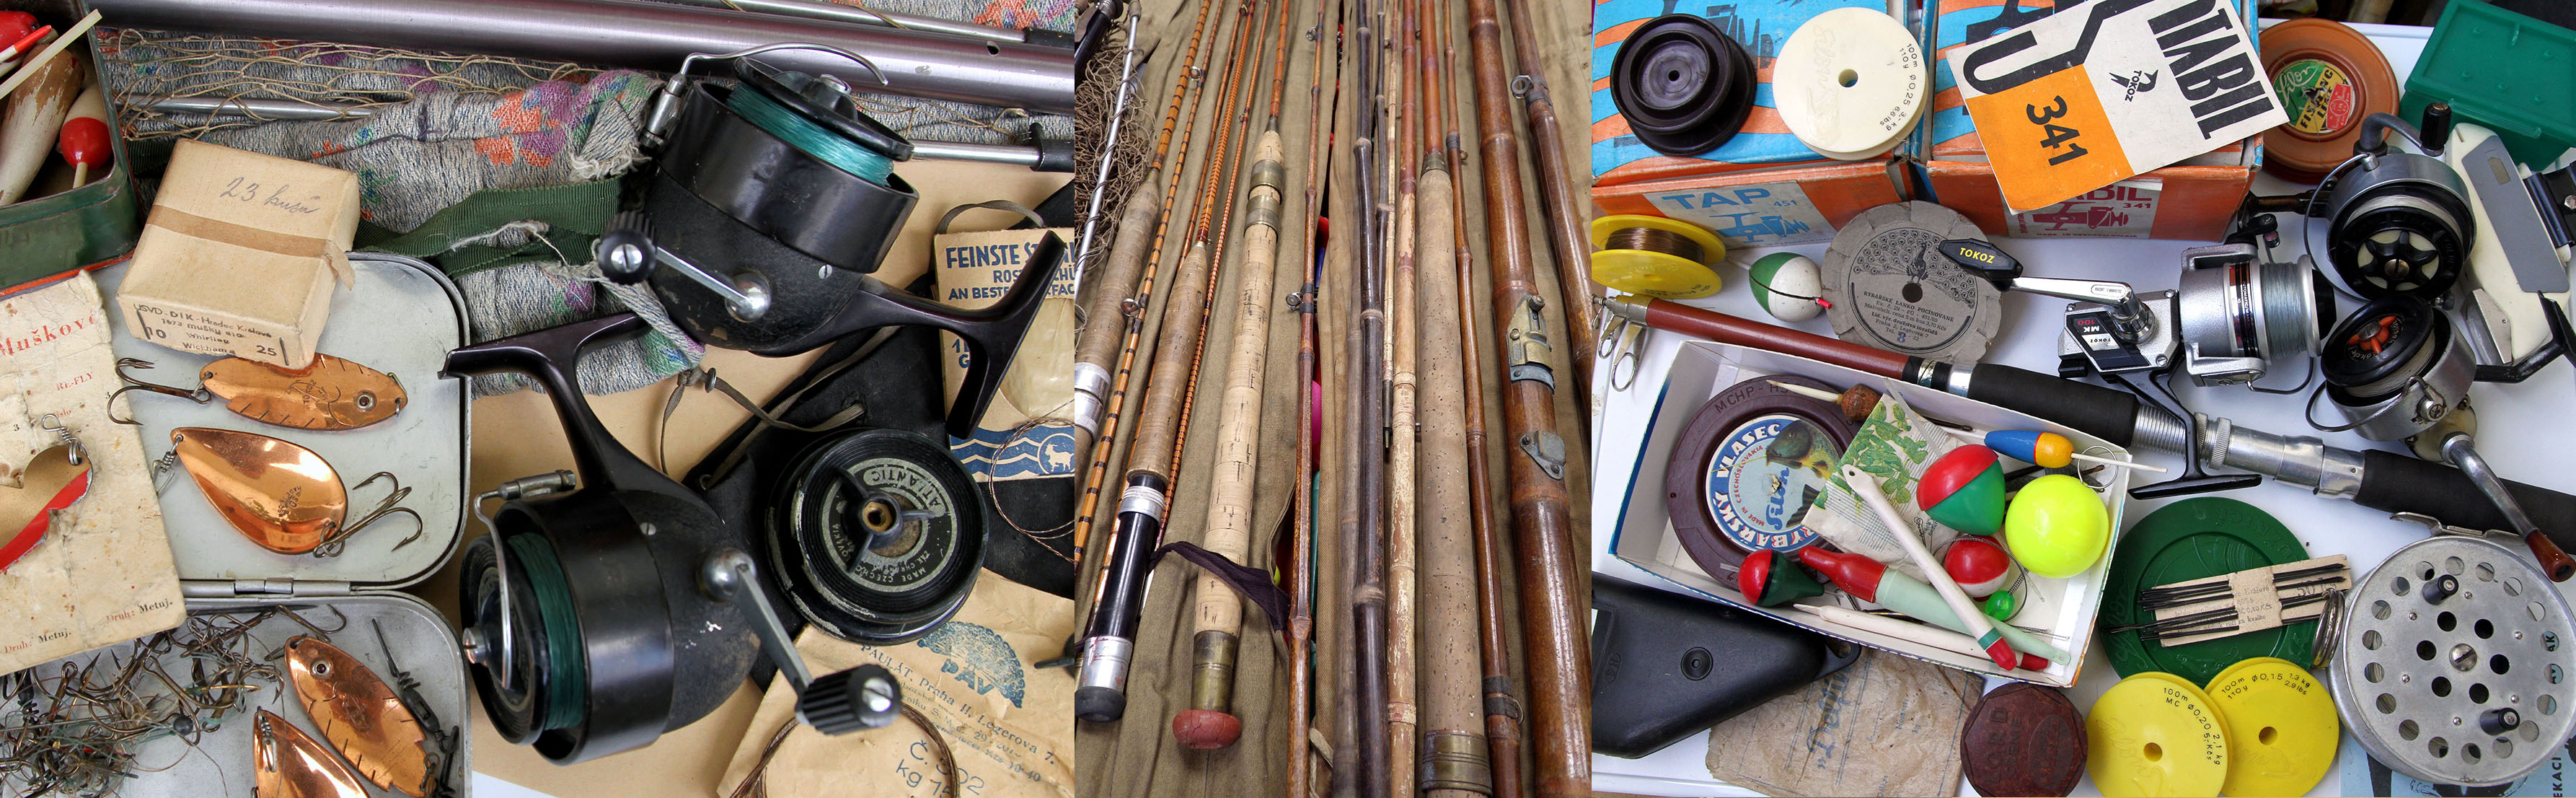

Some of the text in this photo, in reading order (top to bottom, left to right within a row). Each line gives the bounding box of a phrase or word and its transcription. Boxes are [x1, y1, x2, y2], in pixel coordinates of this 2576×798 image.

[2125, 70, 2143, 102] TOKOZ
[2026, 95, 2088, 166] 341
[219, 177, 259, 201] 23
[1662, 188, 1770, 209] TAP
[945, 244, 1020, 268] FEINSTE
[1959, 247, 1995, 264] TOKOZ
[948, 288, 968, 300] AN
[256, 345, 277, 356] 25
[1716, 424, 1780, 478] VLASEC
[871, 470, 941, 507] ATLANTIC
[1748, 514, 1765, 527] MADE
[902, 567, 927, 582] MADE
[105, 598, 173, 623] Druh: Metuj.
[4, 628, 72, 654] Druh: Metuj.
[2301, 679, 2311, 688] kg
[2166, 698, 2180, 707] MC
[919, 677, 956, 706] Praha
[977, 714, 1038, 754] Legerova
[1045, 752, 1055, 765] 7.
[910, 740, 928, 766] Č.
[2214, 755, 2223, 766] kg
[896, 759, 923, 788] kg
